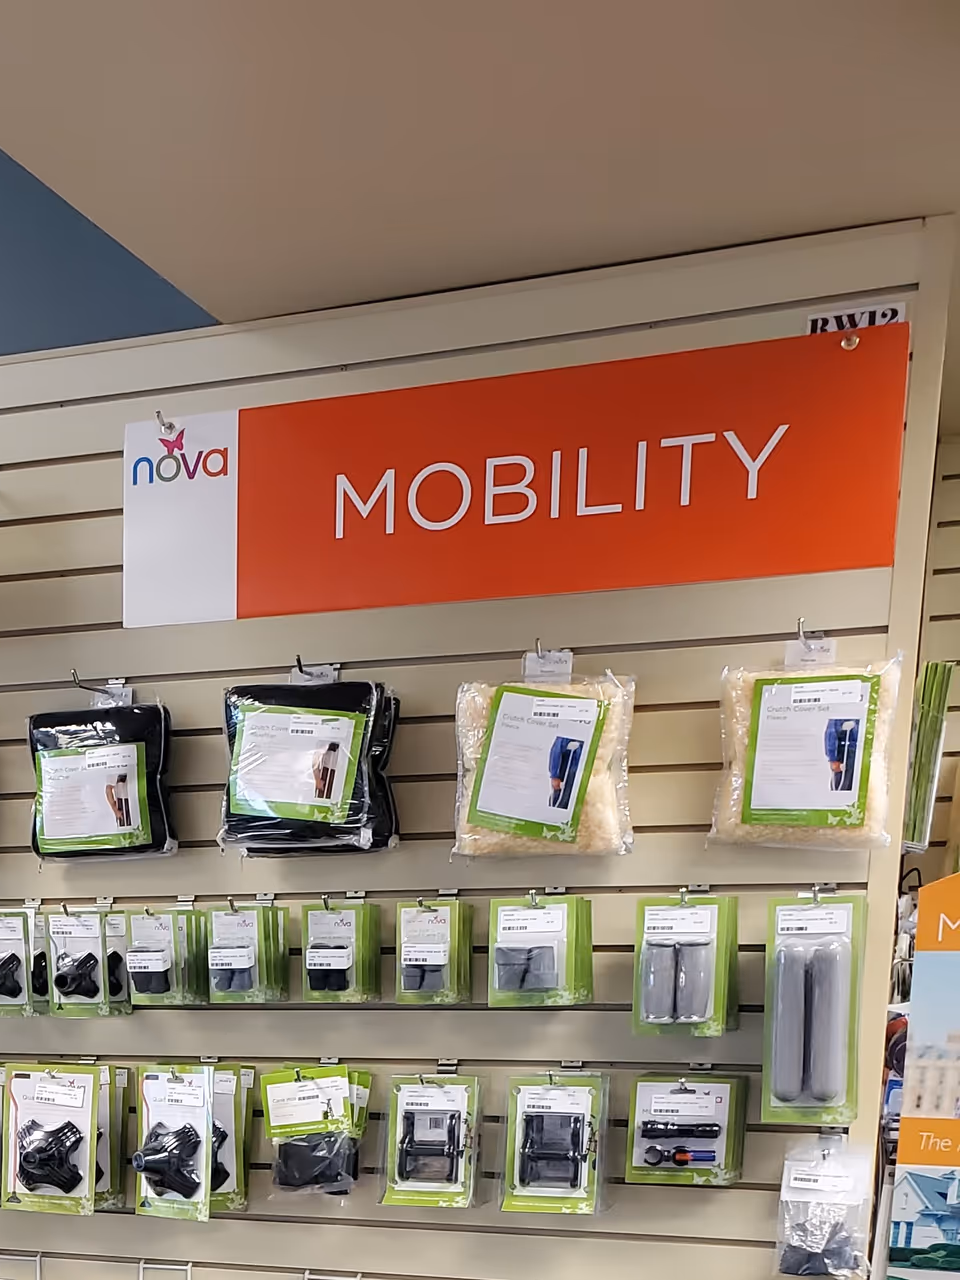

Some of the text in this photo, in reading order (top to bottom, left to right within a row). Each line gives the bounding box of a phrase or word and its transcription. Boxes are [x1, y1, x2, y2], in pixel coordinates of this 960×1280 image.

[132, 445, 229, 487] nova
[334, 423, 791, 540] MOBILITY
[427, 917, 447, 925] nova
[919, 1131, 953, 1152] The
